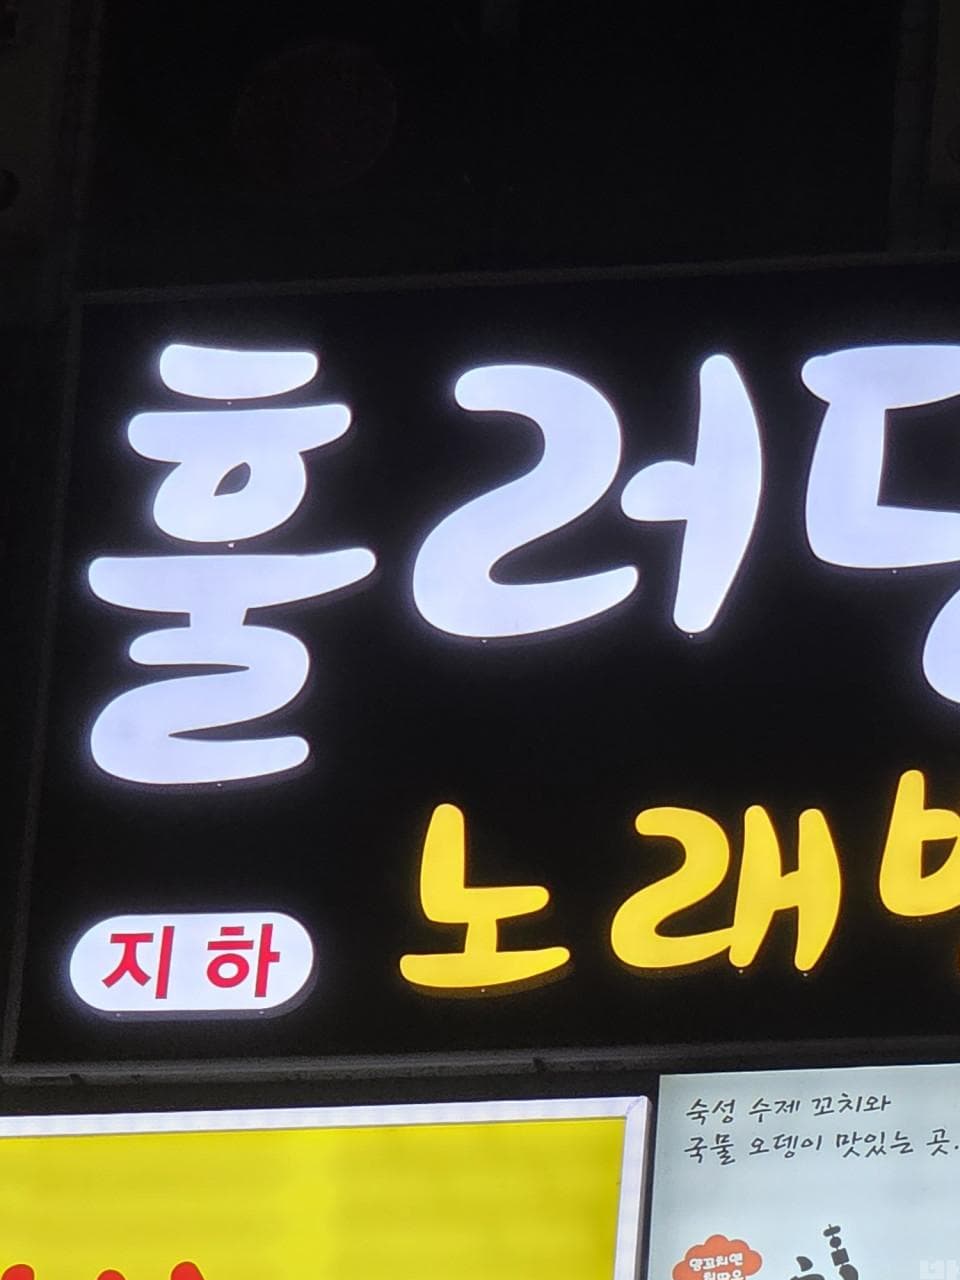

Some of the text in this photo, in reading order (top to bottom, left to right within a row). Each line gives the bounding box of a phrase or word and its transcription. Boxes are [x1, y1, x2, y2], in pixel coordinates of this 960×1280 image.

[101, 921, 281, 999] 지하
[686, 1092, 892, 1125] 숙성 수제 꼬치와
[684, 1133, 736, 1166] 국물
[749, 1134, 823, 1159] 오뎅이
[836, 1131, 914, 1158] 맛있는
